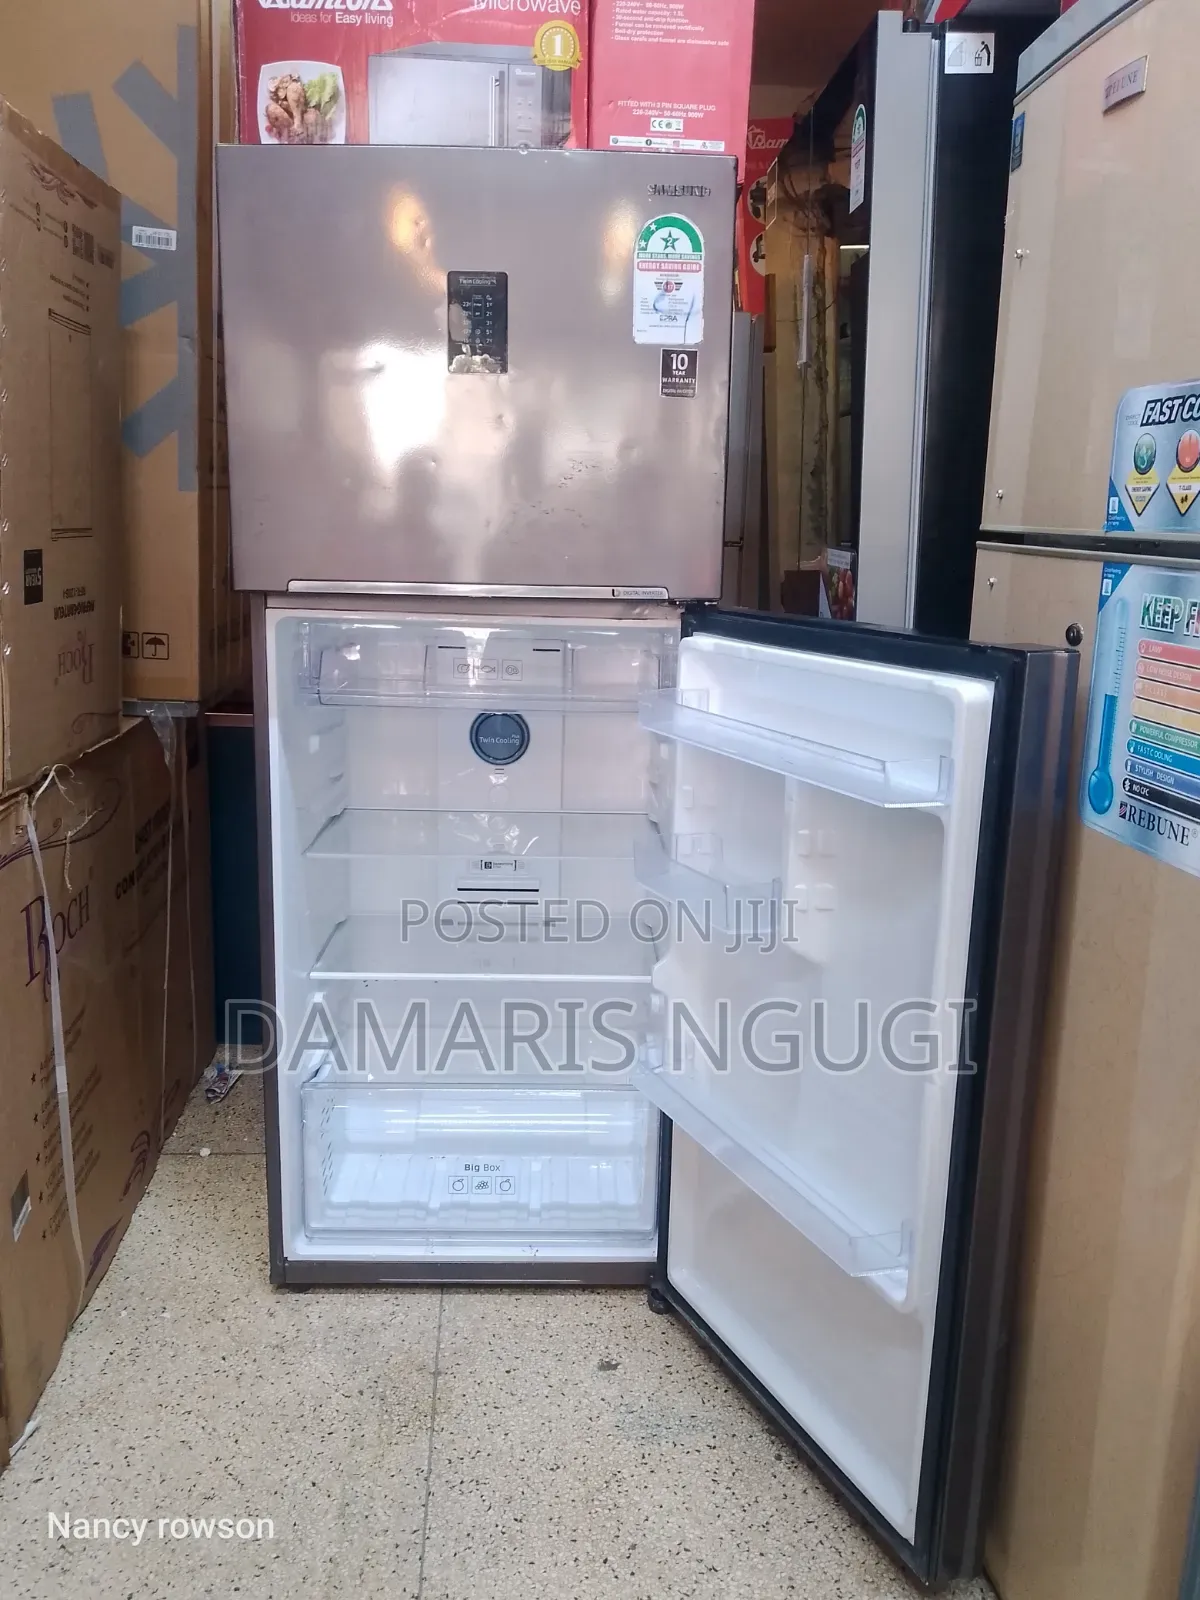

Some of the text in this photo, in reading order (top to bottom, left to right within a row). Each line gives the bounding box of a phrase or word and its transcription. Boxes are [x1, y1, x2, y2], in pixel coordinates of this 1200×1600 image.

[291, 12, 393, 27] Ideas for Easy living
[552, 34, 563, 56] 1
[673, 103, 698, 111] SQUARE
[648, 184, 711, 197] SAMSUNG
[667, 236, 674, 247] 2
[639, 262, 700, 271] ENERGY SAVING GUIDE
[670, 353, 688, 370] 10
[1141, 397, 1183, 426] FAST
[1140, 593, 1200, 638] KEEP F
[1148, 646, 1163, 654] LAMP
[1146, 665, 1159, 675] LOW
[1174, 670, 1192, 681] DESIGN
[495, 736, 520, 746] Cooling
[1140, 725, 1198, 749] POWERFUL COMPRESSOR
[1135, 764, 1175, 785] STYLISH DESIGN
[1132, 784, 1150, 796] NO CFC
[1128, 802, 1190, 847] REBUNE
[464, 1163, 501, 1172] Big Box
